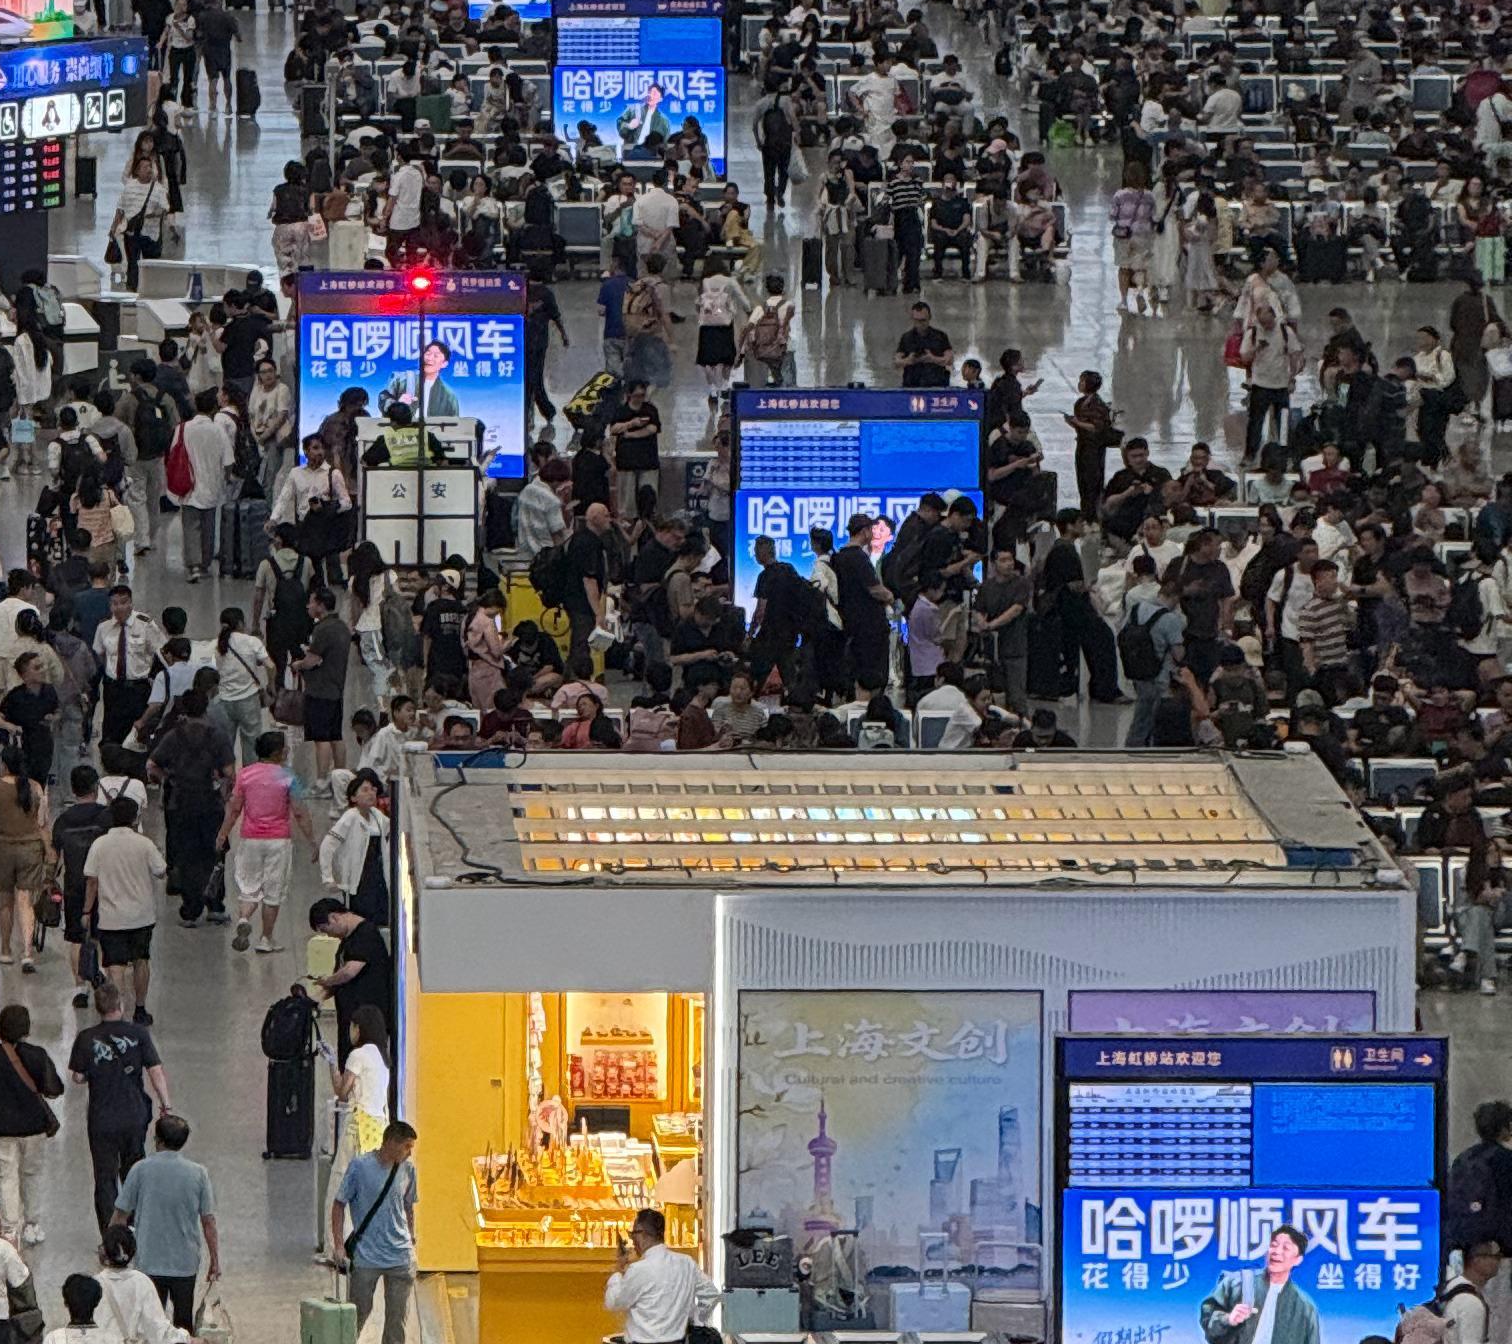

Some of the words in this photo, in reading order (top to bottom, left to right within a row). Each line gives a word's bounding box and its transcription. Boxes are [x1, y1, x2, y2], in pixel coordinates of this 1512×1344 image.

[562, 69, 718, 101] 哈啰顺风车
[310, 320, 516, 361] 哈啰顺风车
[310, 360, 377, 378] 花得少
[453, 360, 515, 378] 坐得好
[391, 481, 447, 499] 公安
[748, 495, 922, 538] 哈啰顺风
[773, 1018, 1009, 1066] 上海文创
[1095, 1051, 1222, 1068] 上海虹桥站欢迎您
[784, 1073, 845, 1087] Cultural
[849, 1074, 879, 1086] and
[1082, 1197, 1423, 1261] 哈啰顺风车
[736, 1248, 783, 1269] LEE
[1082, 1262, 1190, 1291] 花得少
[1317, 1262, 1422, 1292] 坐得好
